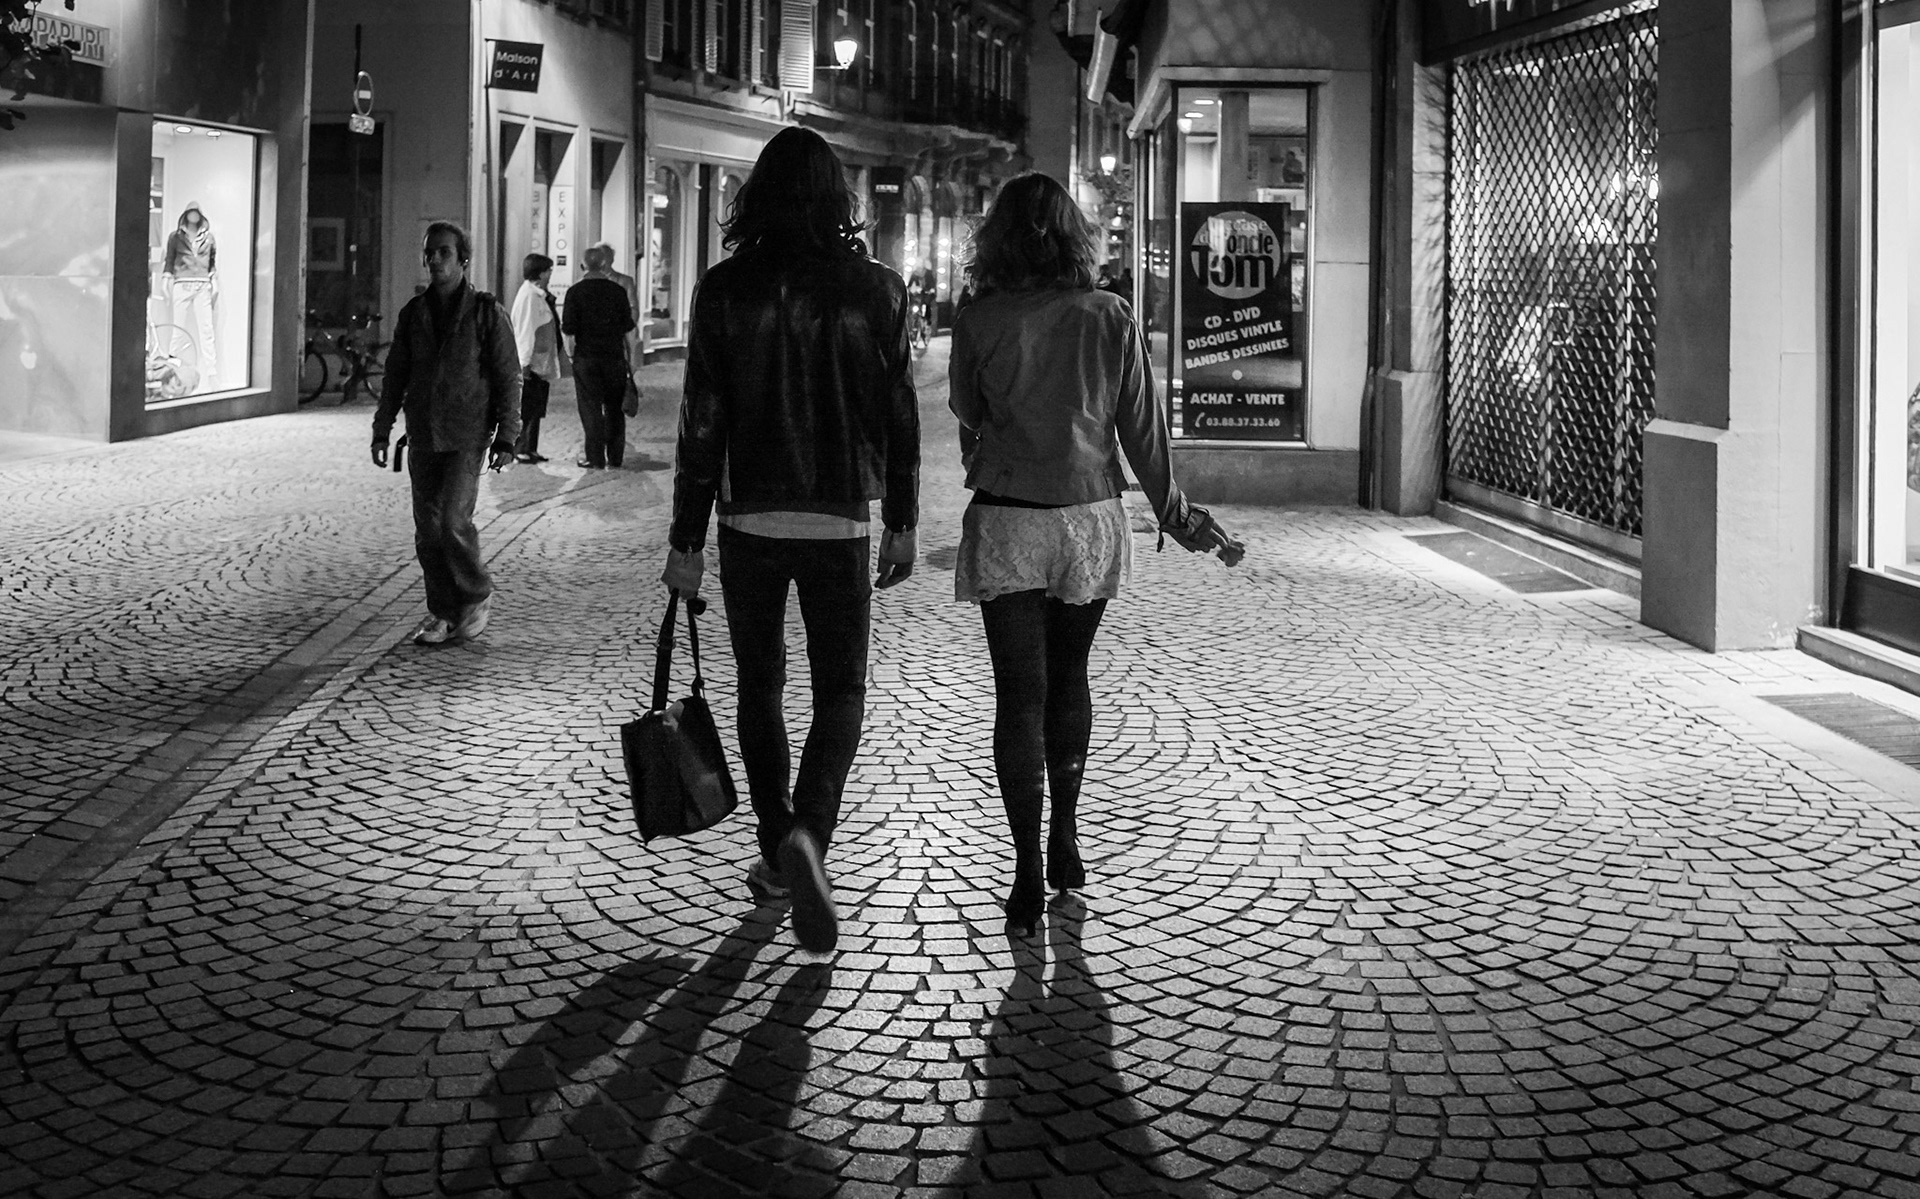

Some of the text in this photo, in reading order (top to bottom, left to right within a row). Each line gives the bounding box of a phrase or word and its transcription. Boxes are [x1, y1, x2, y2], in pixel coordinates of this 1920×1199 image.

[497, 51, 538, 65] Maison
[556, 191, 567, 250] EXPO
[1204, 315, 1222, 329] CD
[1233, 306, 1261, 323] DVD
[1186, 320, 1283, 350] DISQUES VINYLE
[1185, 338, 1289, 370] BANDES DESSINEES
[1190, 393, 1234, 404] ACHAT
[1245, 393, 1285, 405] VENTE
[1206, 417, 1280, 427] 03.88.37.33.60
